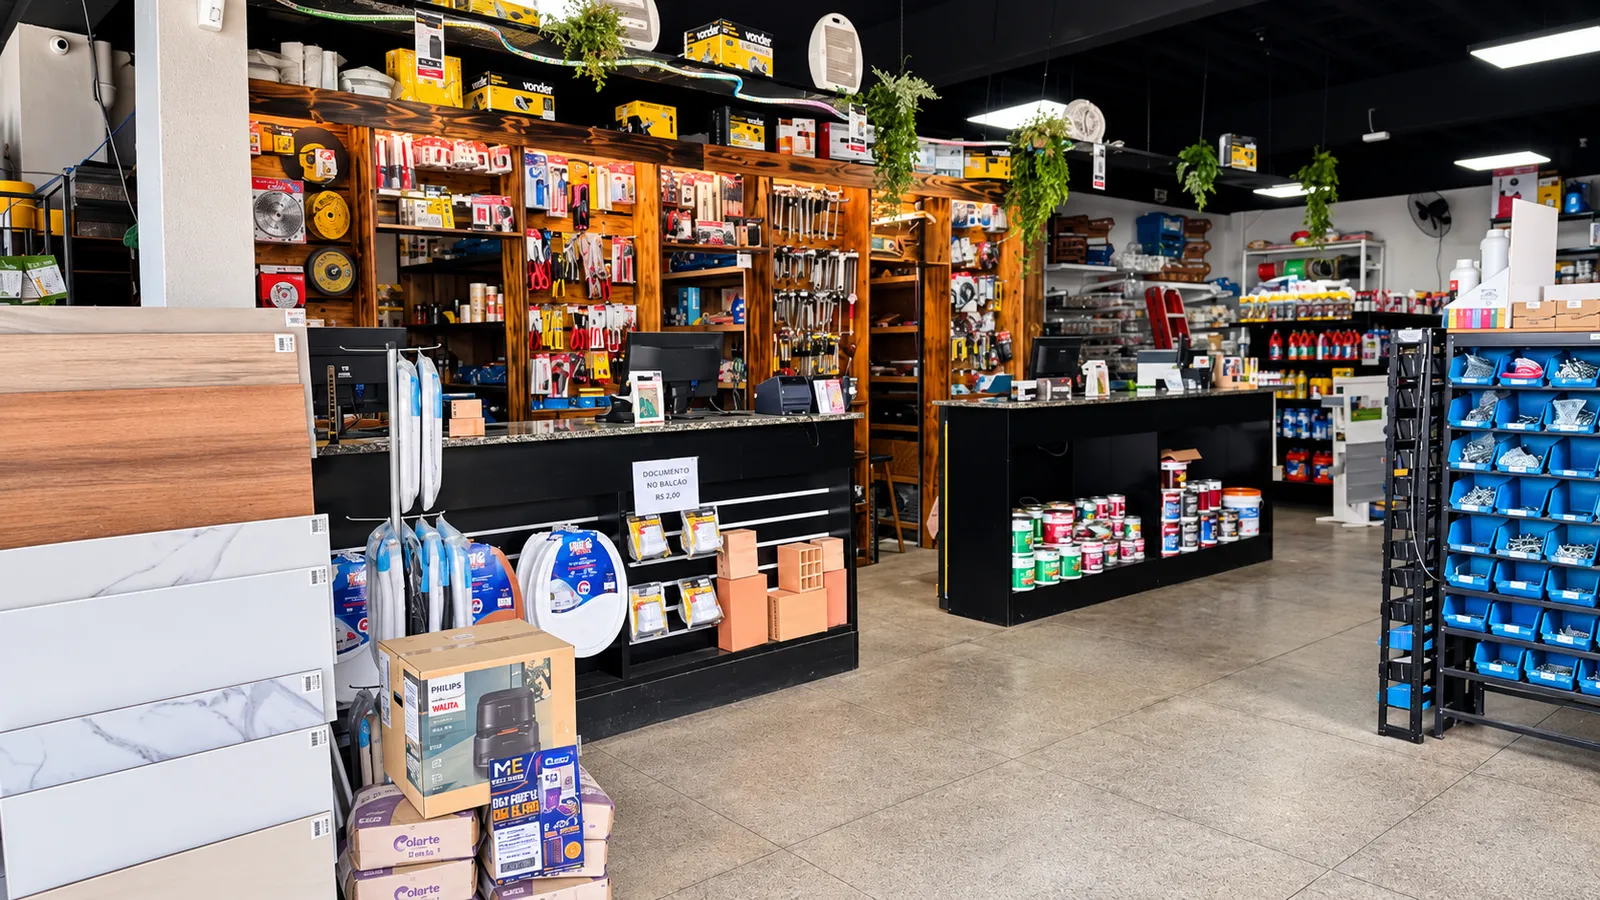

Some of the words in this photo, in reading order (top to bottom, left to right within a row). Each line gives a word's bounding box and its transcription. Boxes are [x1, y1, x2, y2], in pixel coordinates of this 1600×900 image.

[696, 25, 720, 40] vonder
[745, 31, 772, 47] vonder
[523, 82, 553, 94] vonder
[643, 467, 690, 478] DOCUMENTO
[431, 682, 461, 694] PHILIPS
[432, 702, 459, 713] WALITA
[393, 835, 440, 852] Colarte
[394, 885, 440, 900] Colarte
